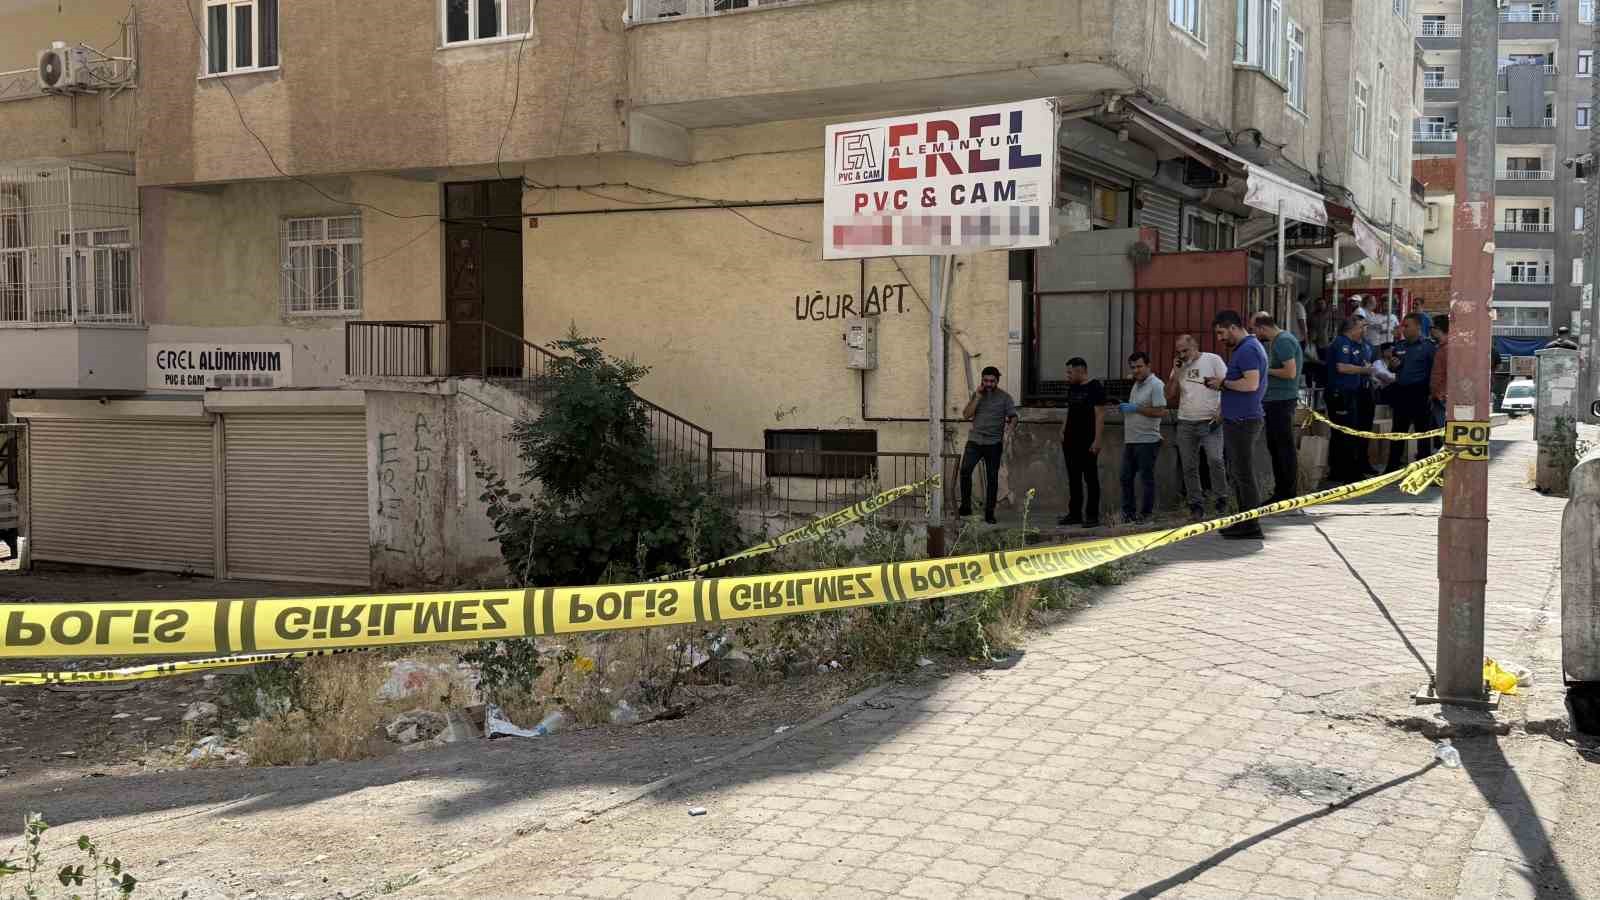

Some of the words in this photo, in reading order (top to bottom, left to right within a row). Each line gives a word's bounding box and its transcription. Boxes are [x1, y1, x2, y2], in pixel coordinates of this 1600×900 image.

[888, 110, 1041, 181] EREL
[838, 171, 853, 182] PVC
[863, 169, 880, 180] CAM
[854, 189, 908, 213] PVC
[920, 186, 937, 208] &
[950, 179, 1017, 205] CAM
[156, 349, 195, 370] EREL
[165, 374, 178, 385] PVC
[187, 374, 205, 385] CAM
